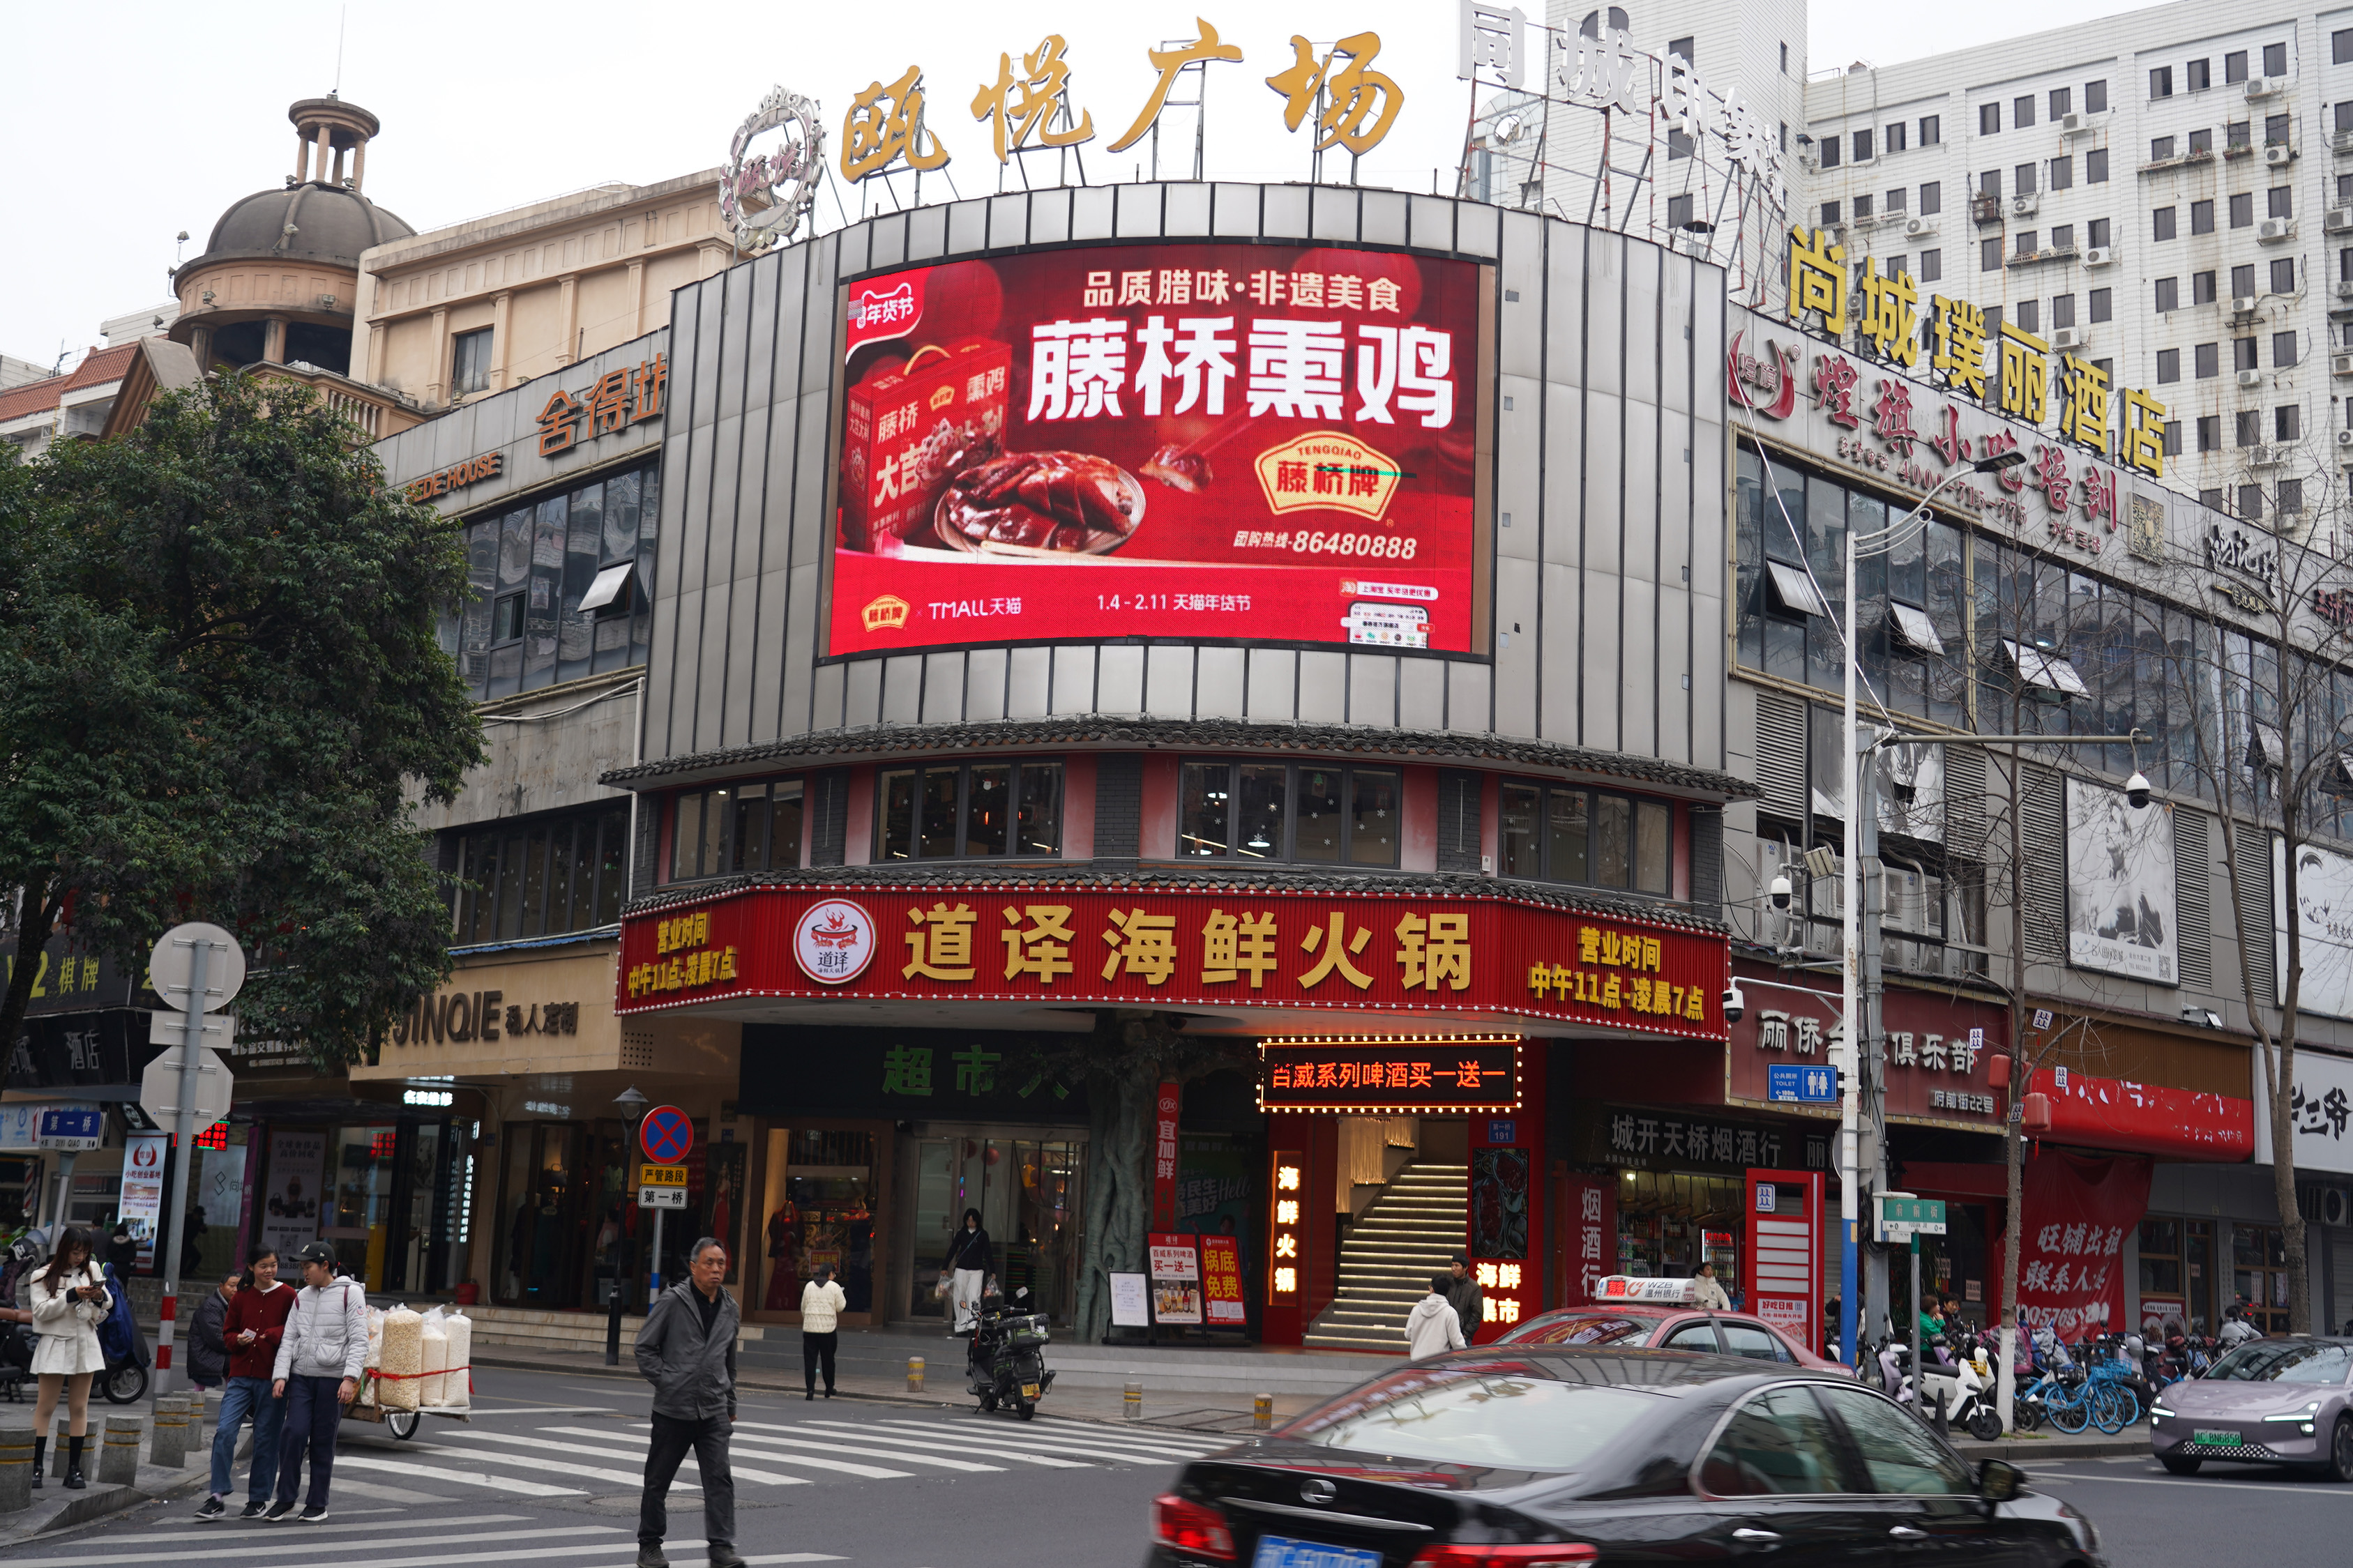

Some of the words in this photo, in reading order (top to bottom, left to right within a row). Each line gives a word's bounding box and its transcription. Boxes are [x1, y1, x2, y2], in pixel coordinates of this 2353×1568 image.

[1084, 268, 1402, 314] 品质腊味·非遗美食
[867, 296, 914, 325] 年货节
[1787, 224, 2166, 478] 尚城璞丽酒店
[1027, 315, 1453, 429] 藤桥熏鸡
[1739, 352, 1778, 393] 煌旗
[877, 402, 919, 444] 藤桥
[1297, 445, 1362, 460] TENGQIAO
[1812, 353, 2117, 533] 煌旗小吃培训
[1838, 436, 1889, 471] 免费电话
[446, 451, 504, 489] HOUSE
[1276, 460, 1380, 498] 藤桥牌
[1174, 594, 1251, 611] 天猫年货节
[657, 912, 711, 954] 营业时间
[902, 901, 1471, 992] 道译海鲜火锅
[817, 951, 849, 973] 道译
[1577, 926, 1662, 973] 营业时间
[59, 954, 100, 995] 棋牌
[393, 990, 504, 1045] JINQIE
[505, 1001, 580, 1037] 私人定制
[63, 1029, 100, 1070] 酒店
[1756, 1010, 1979, 1075] 丽侨俱乐部
[1272, 1060, 1506, 1089] 百威系列啤酒买一送一
[403, 1089, 453, 1107] 名表维修
[1931, 1089, 1994, 1114] 府前街22号
[50, 1115, 92, 1132] 第一桥
[1492, 1122, 1511, 1131] 第一桥
[1494, 1132, 1511, 1141] 191
[68, 1139, 81, 1148] QIAO
[1157, 1120, 1176, 1180] 宜加鲜
[1611, 1113, 1782, 1169] 城开天桥烟酒行
[125, 1169, 161, 1180] 小吃创业基地
[644, 1169, 684, 1183] 严管路段
[644, 1189, 683, 1205] 第一桥
[1896, 1203, 1938, 1219] 府前街
[1275, 1166, 1300, 1293] 海鲜火锅
[1581, 1187, 1602, 1297] 烟酒行
[2037, 1222, 2123, 1257] 旺铺出租
[1153, 1249, 1194, 1259] 百威系列啤酒
[1154, 1260, 1195, 1273] 买一送一
[1204, 1248, 1236, 1273] 锅底
[1206, 1274, 1239, 1299] 免费
[1476, 1262, 1522, 1290] 海鲜
[1644, 1289, 1681, 1298] 温州银行
[1762, 1300, 1794, 1311] 好吃日报
